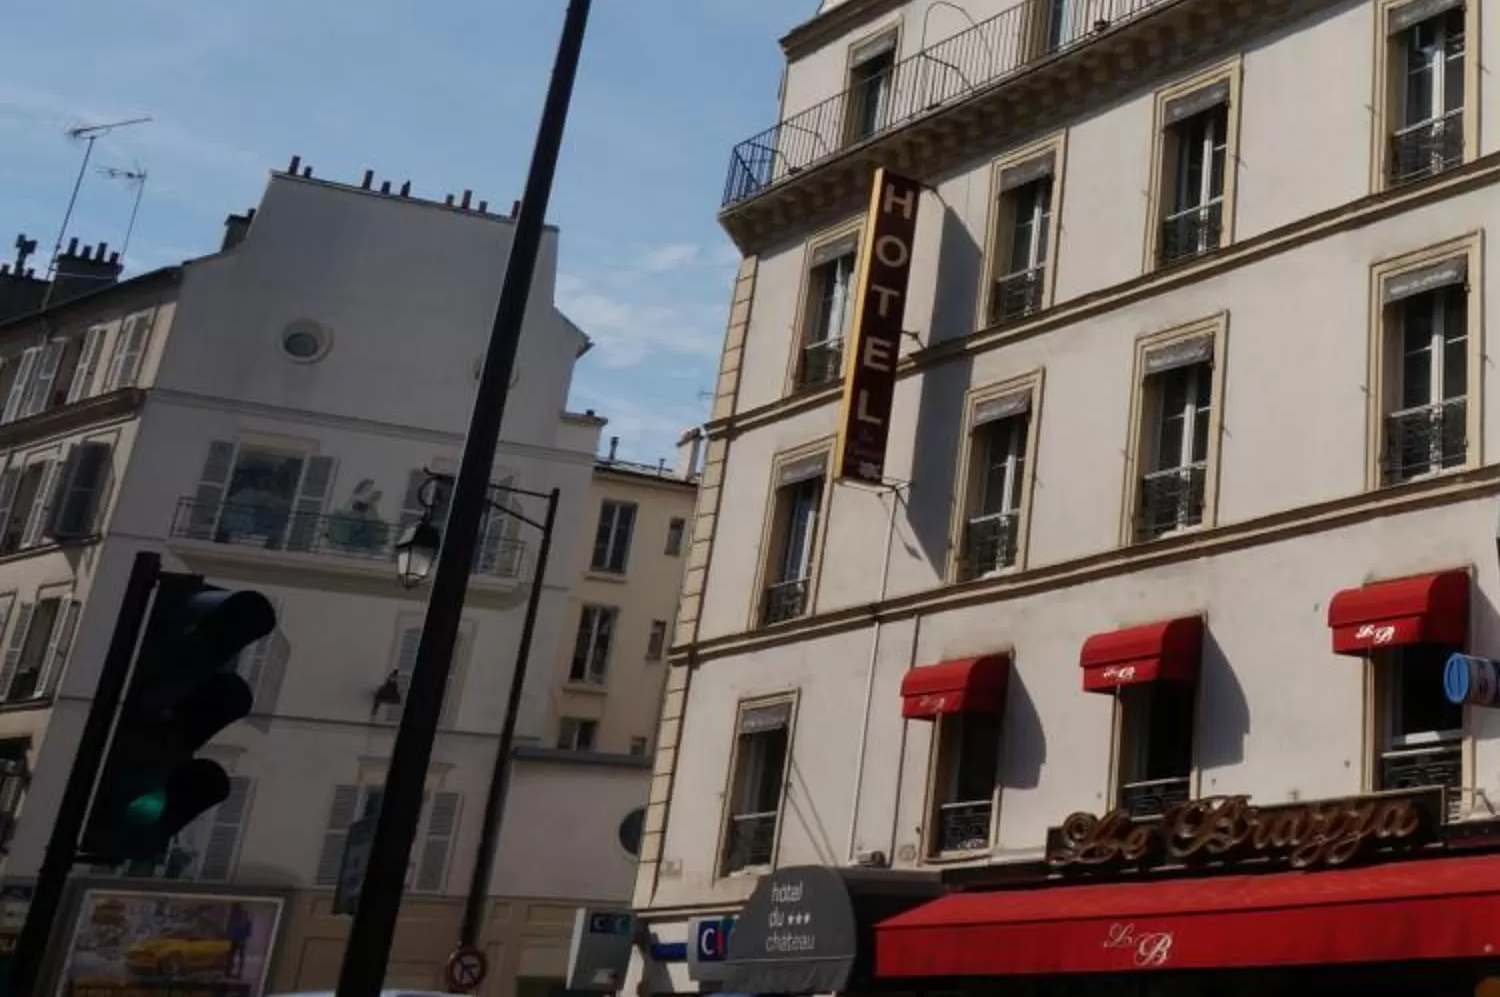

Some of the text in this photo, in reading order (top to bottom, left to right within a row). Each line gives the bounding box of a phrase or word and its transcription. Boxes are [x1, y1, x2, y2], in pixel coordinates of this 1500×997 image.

[857, 183, 914, 425] HOTEL
[1046, 809, 1150, 866] Le
[767, 906, 785, 927] du
